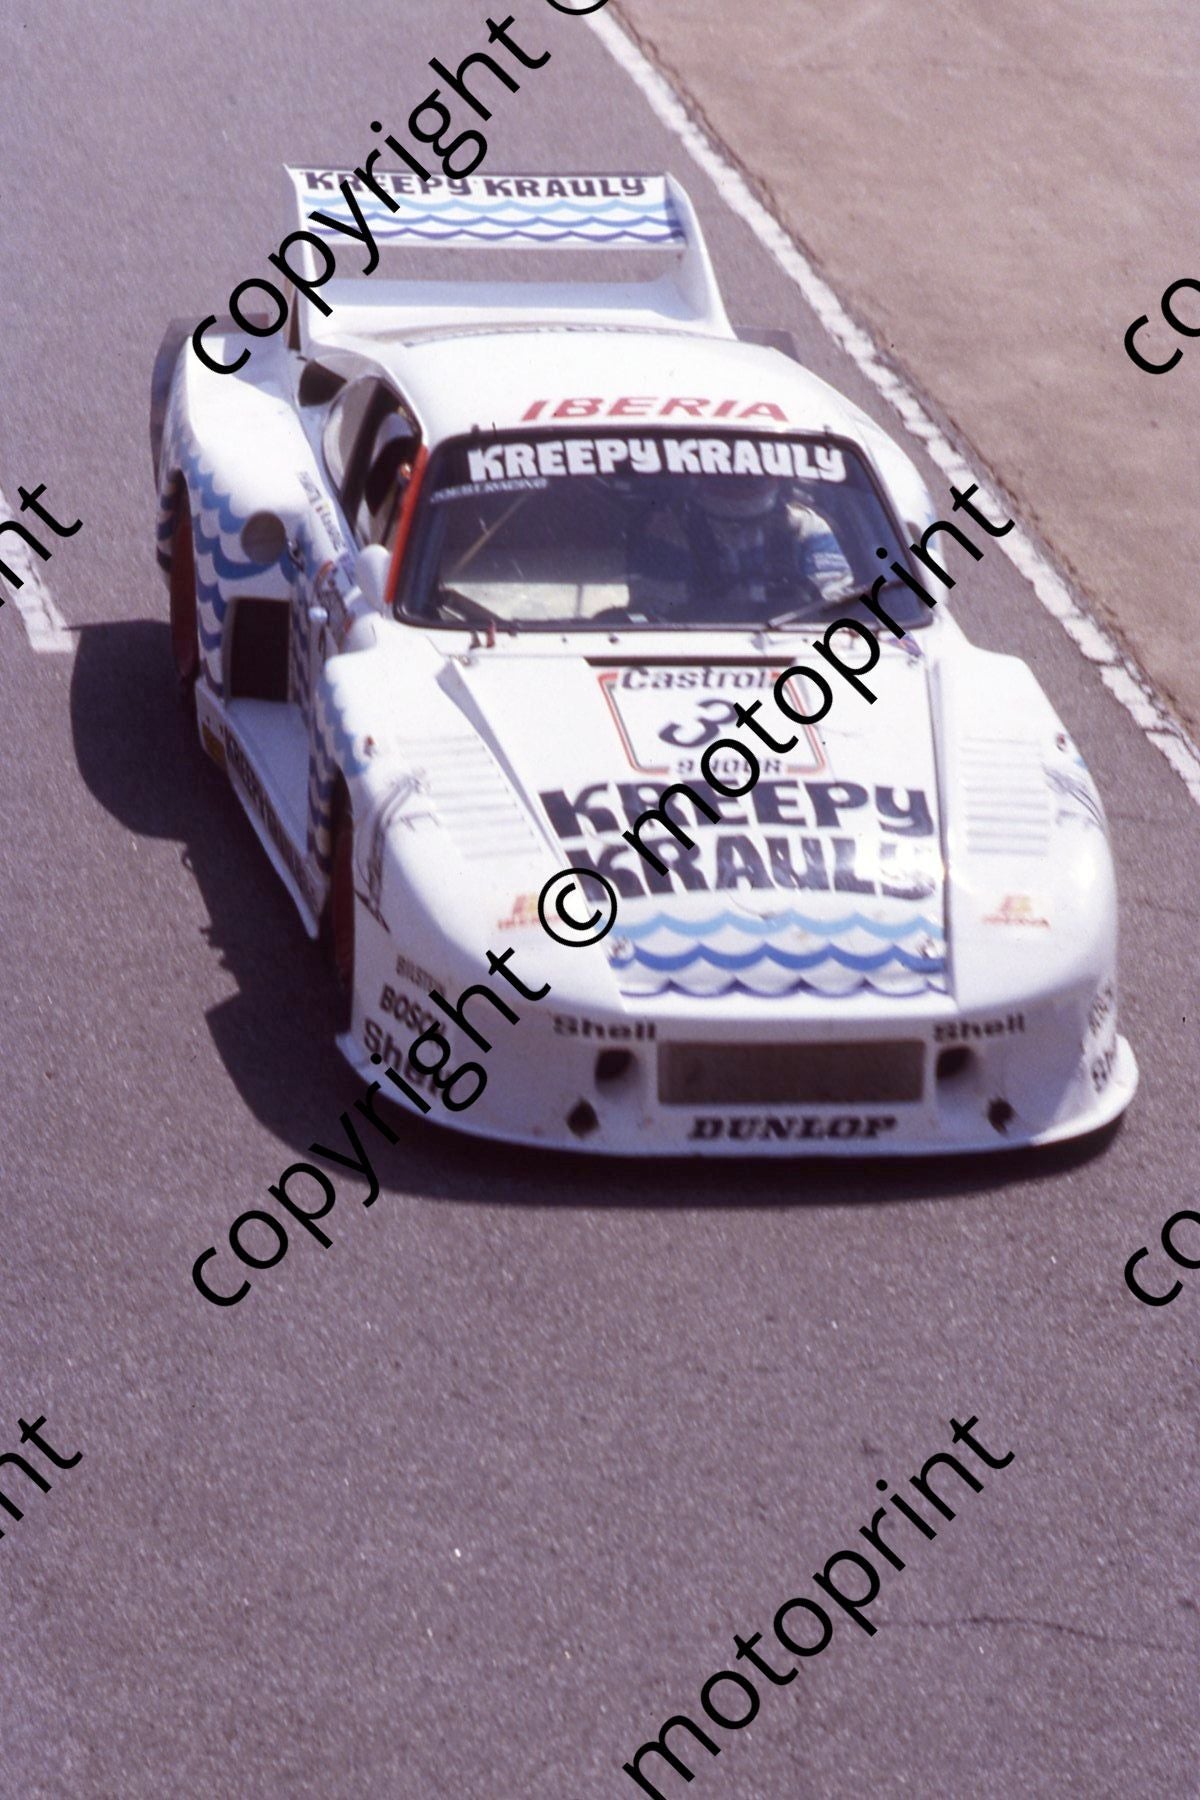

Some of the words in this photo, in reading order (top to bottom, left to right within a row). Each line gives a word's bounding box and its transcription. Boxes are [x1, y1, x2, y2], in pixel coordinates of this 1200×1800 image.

[483, 177, 646, 198] KRAULY
[521, 397, 788, 422] IBERIA
[467, 438, 661, 482] KREEPY
[662, 438, 847, 483] KRAULY
[621, 664, 766, 690] Castrol
[658, 698, 740, 749] 3
[538, 779, 934, 837] KREEPY
[552, 1014, 657, 1041] Shell
[932, 1014, 1025, 1043] Shell
[687, 1115, 898, 1141] DUNLOP
